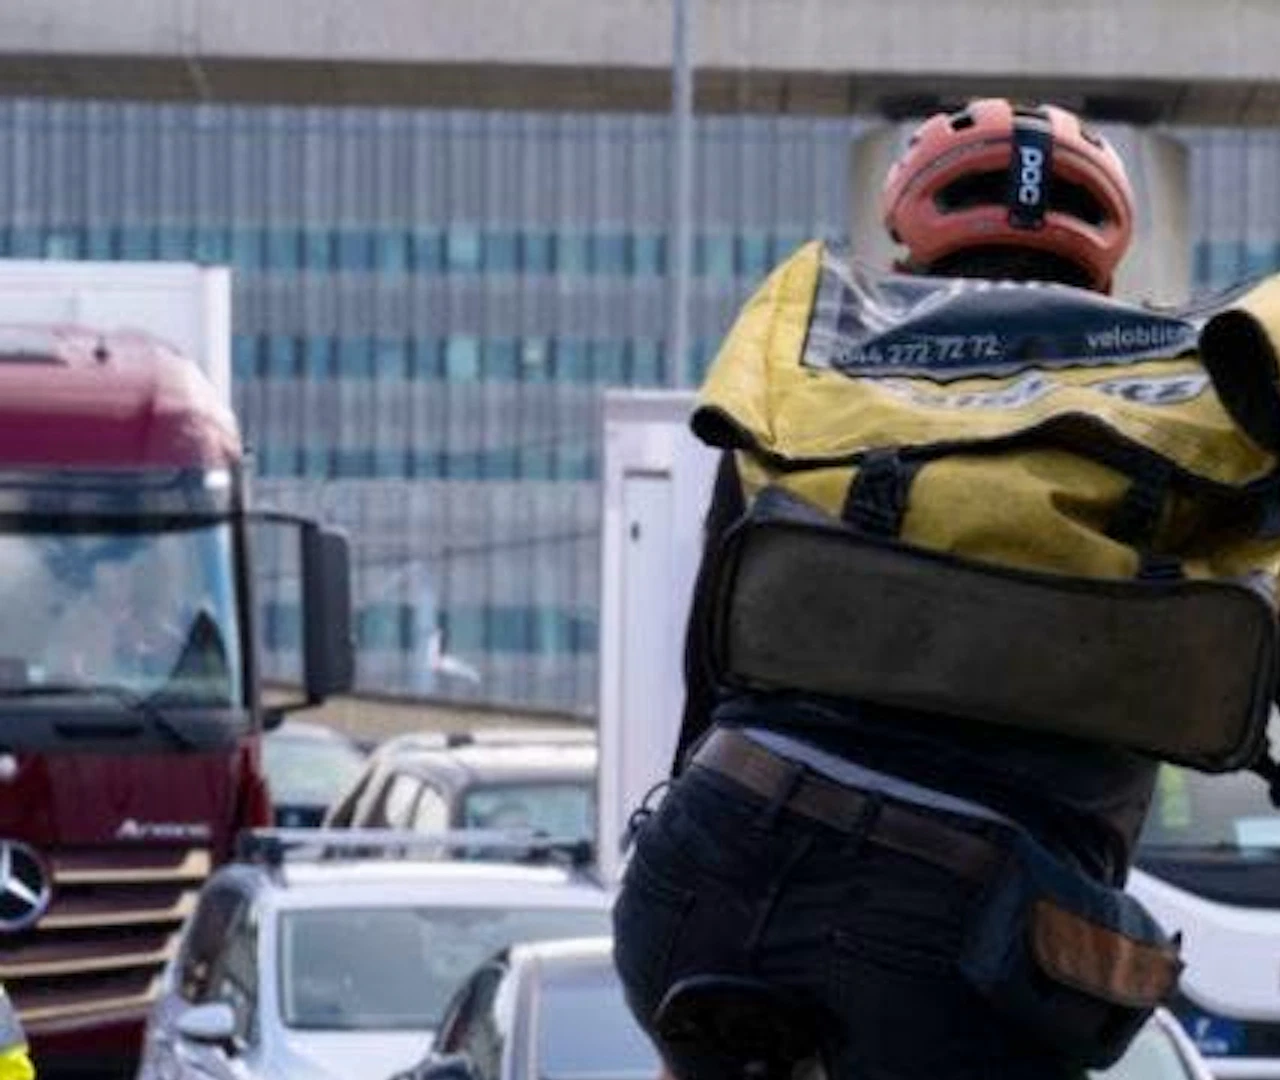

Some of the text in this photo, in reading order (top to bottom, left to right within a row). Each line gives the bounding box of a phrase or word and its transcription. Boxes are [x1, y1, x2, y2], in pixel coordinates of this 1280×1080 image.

[887, 338, 934, 365] 272
[938, 334, 973, 361] 72
[975, 330, 1004, 357] 72
